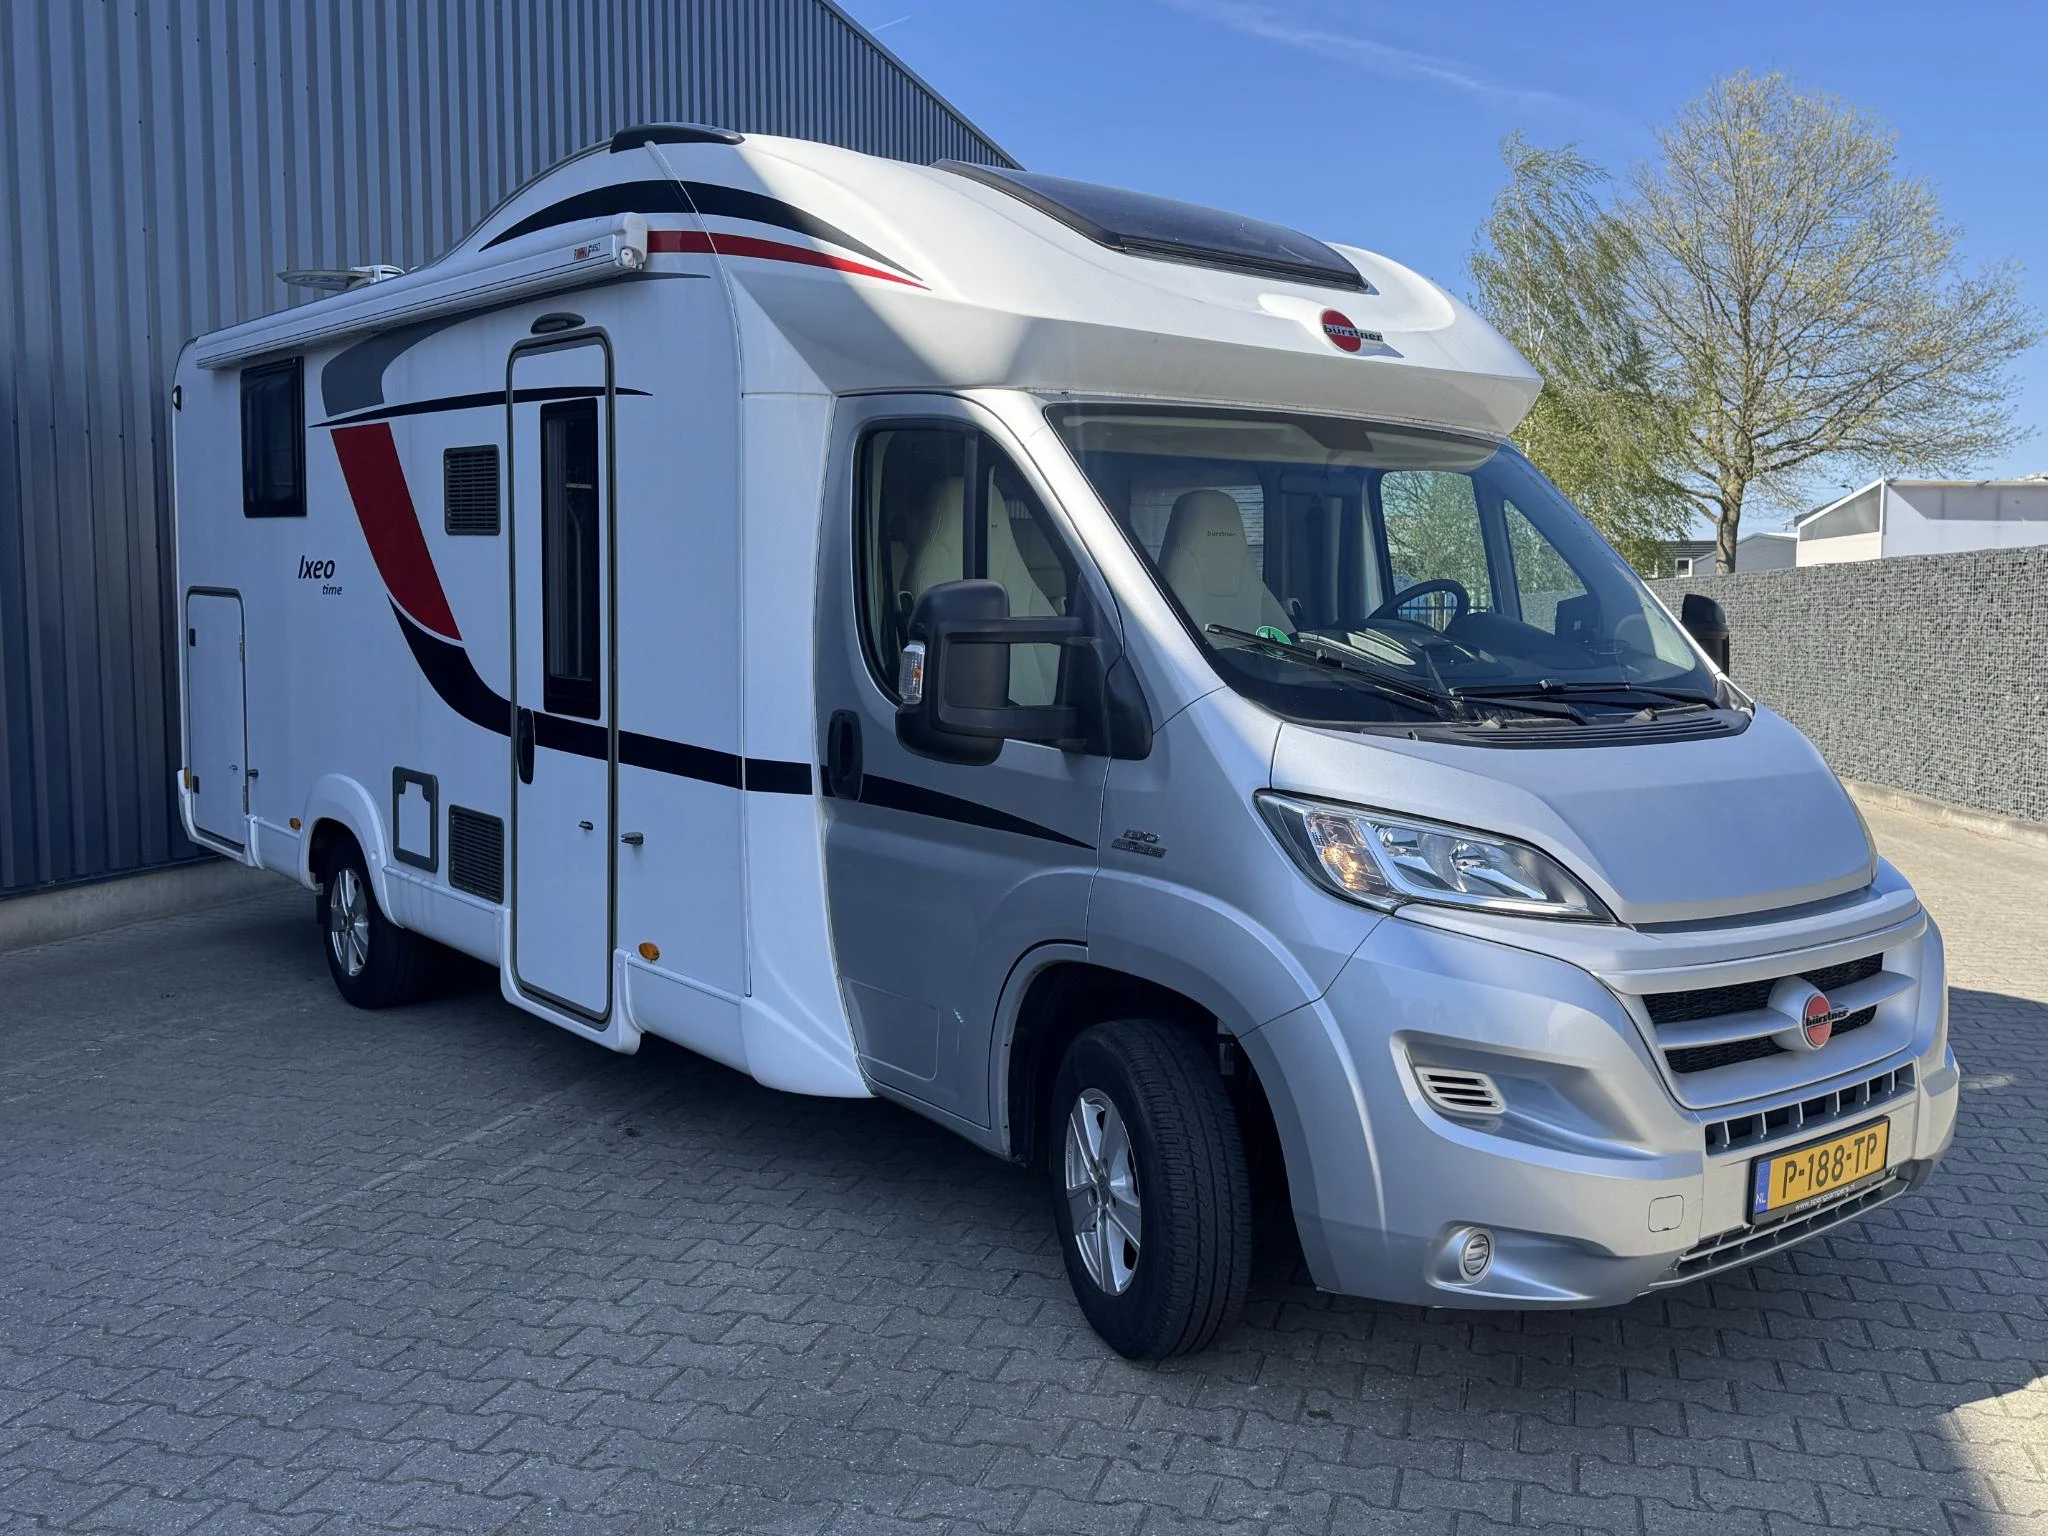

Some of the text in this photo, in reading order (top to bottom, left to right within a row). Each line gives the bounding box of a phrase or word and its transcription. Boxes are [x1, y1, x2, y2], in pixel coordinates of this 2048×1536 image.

[1323, 324, 1384, 342] bürstner
[298, 555, 336, 579] Ixeo
[322, 584, 343, 596] time
[1805, 1008, 1849, 1027] bürstner
[1782, 1132, 1878, 1199] P-188-TP
[1755, 1193, 1767, 1206] NL
